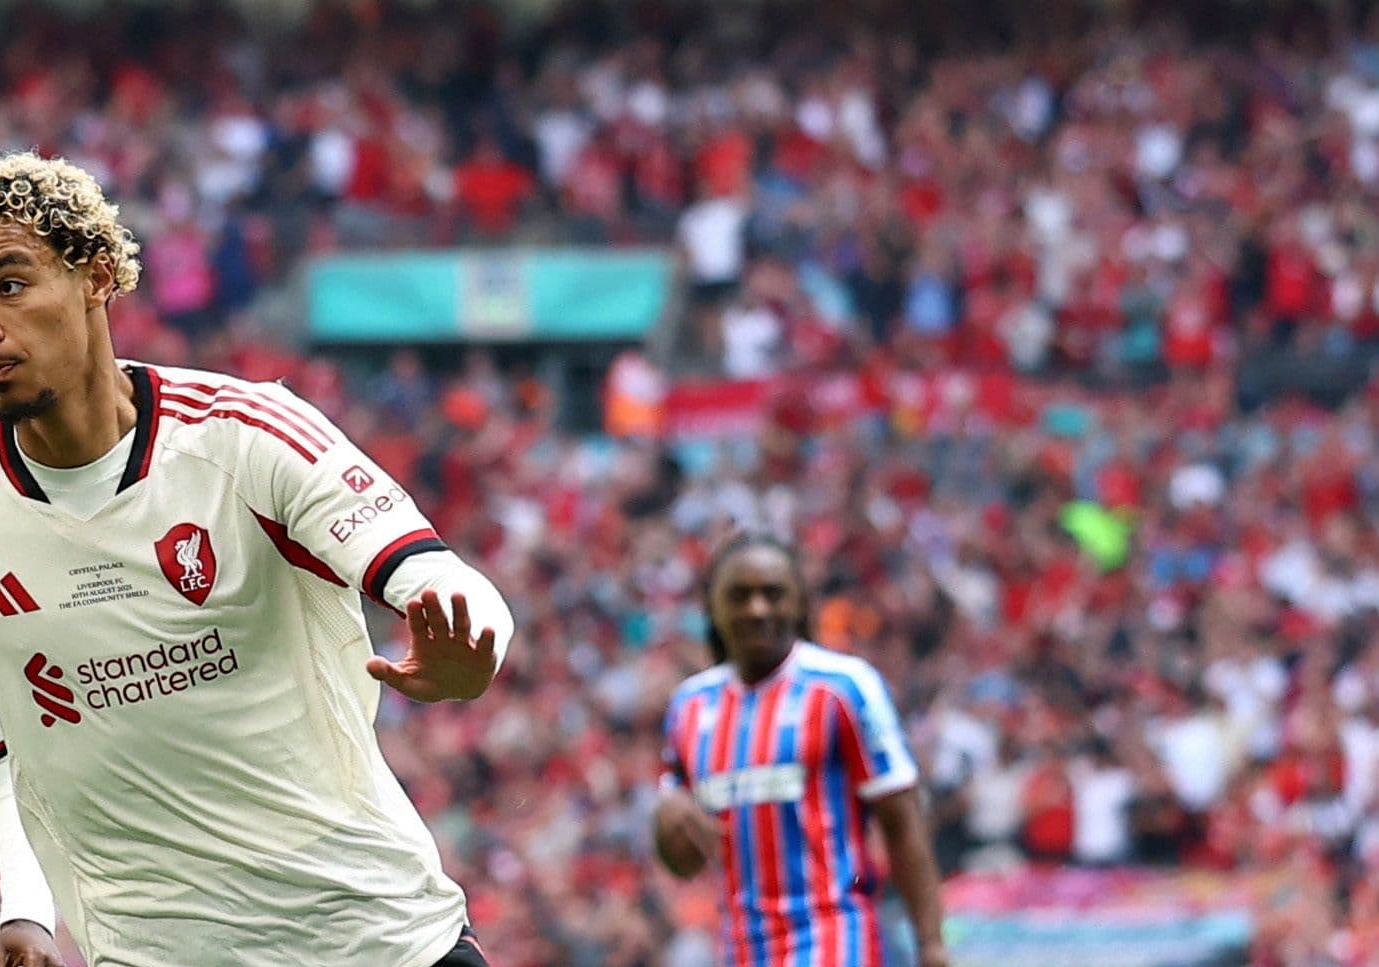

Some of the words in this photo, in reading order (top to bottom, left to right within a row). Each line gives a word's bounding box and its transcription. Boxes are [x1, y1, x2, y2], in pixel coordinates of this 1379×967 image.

[68, 565, 98, 576] CRYSTAL
[98, 562, 125, 571] PALACE
[77, 579, 114, 590] LIVERPOOL
[90, 587, 116, 596] AUGUST
[117, 584, 132, 592] 2025
[82, 594, 124, 606] COMMUNITY
[126, 590, 149, 599] SHIELD
[77, 628, 223, 684] standard
[87, 648, 239, 709] chartered
